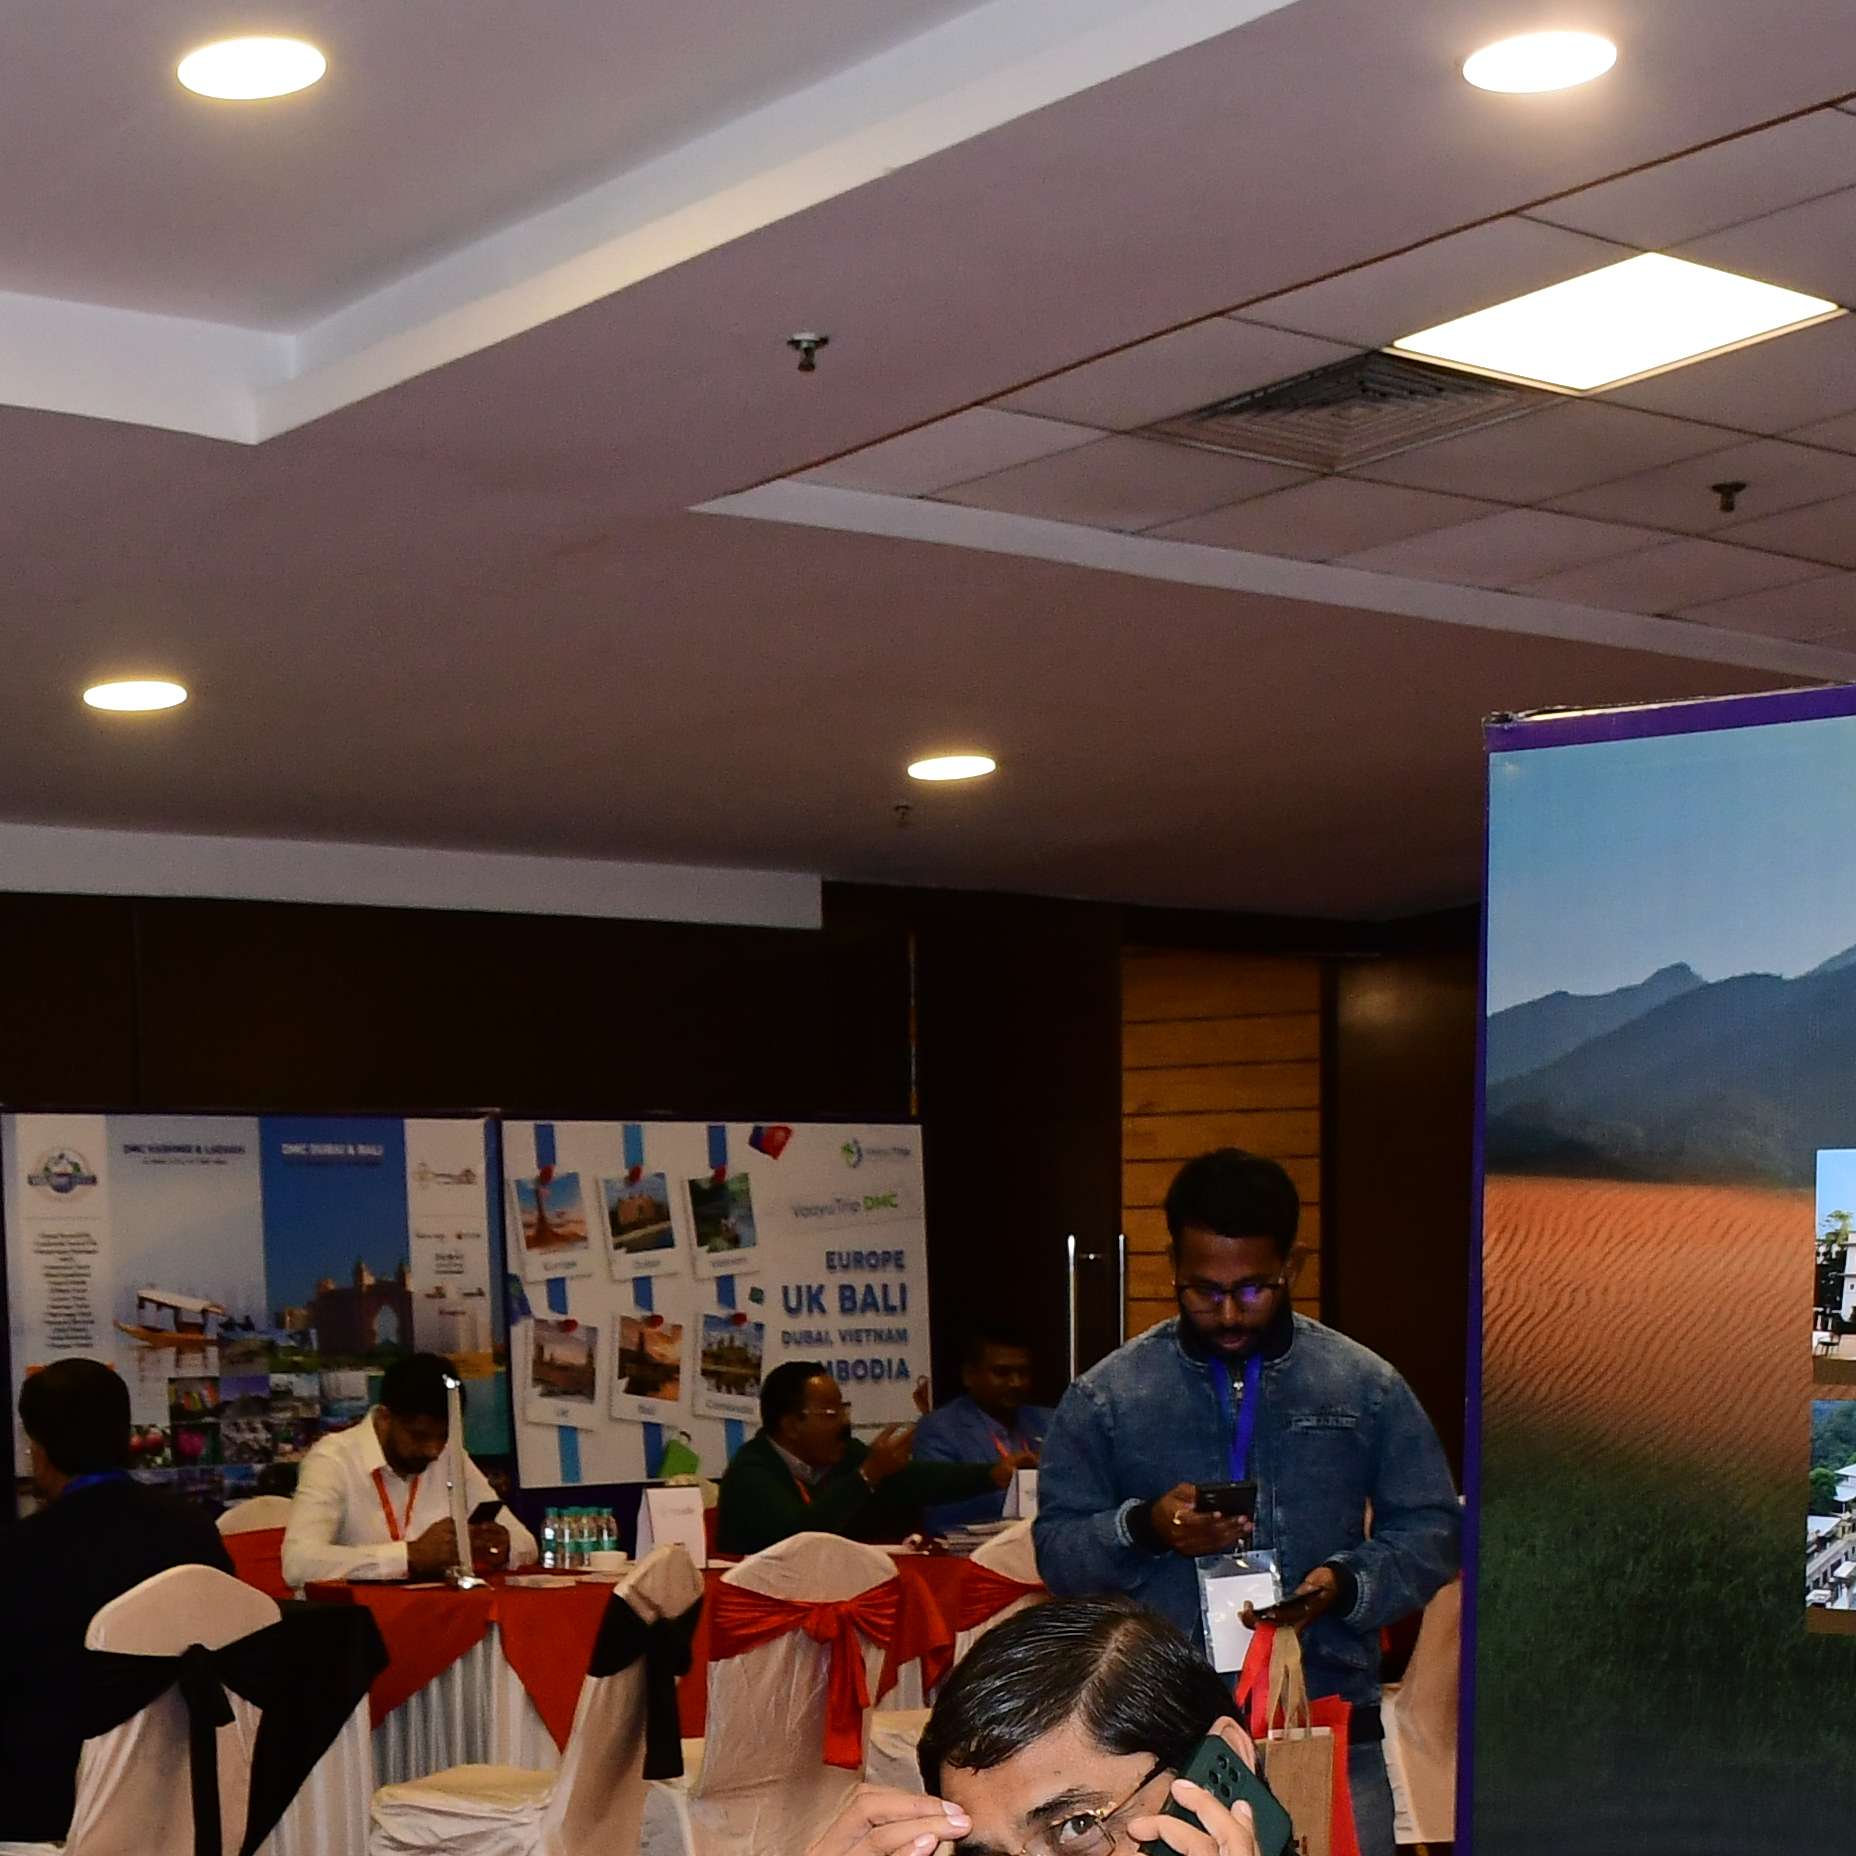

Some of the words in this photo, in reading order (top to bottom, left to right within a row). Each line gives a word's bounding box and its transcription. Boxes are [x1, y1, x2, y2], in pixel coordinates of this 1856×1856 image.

[825, 1249, 906, 1272] EUROPE
[782, 1284, 827, 1314] UK
[838, 1282, 907, 1313] BALI
[838, 1328, 908, 1345] VIETNAM
[818, 1358, 911, 1382] MBODIA
